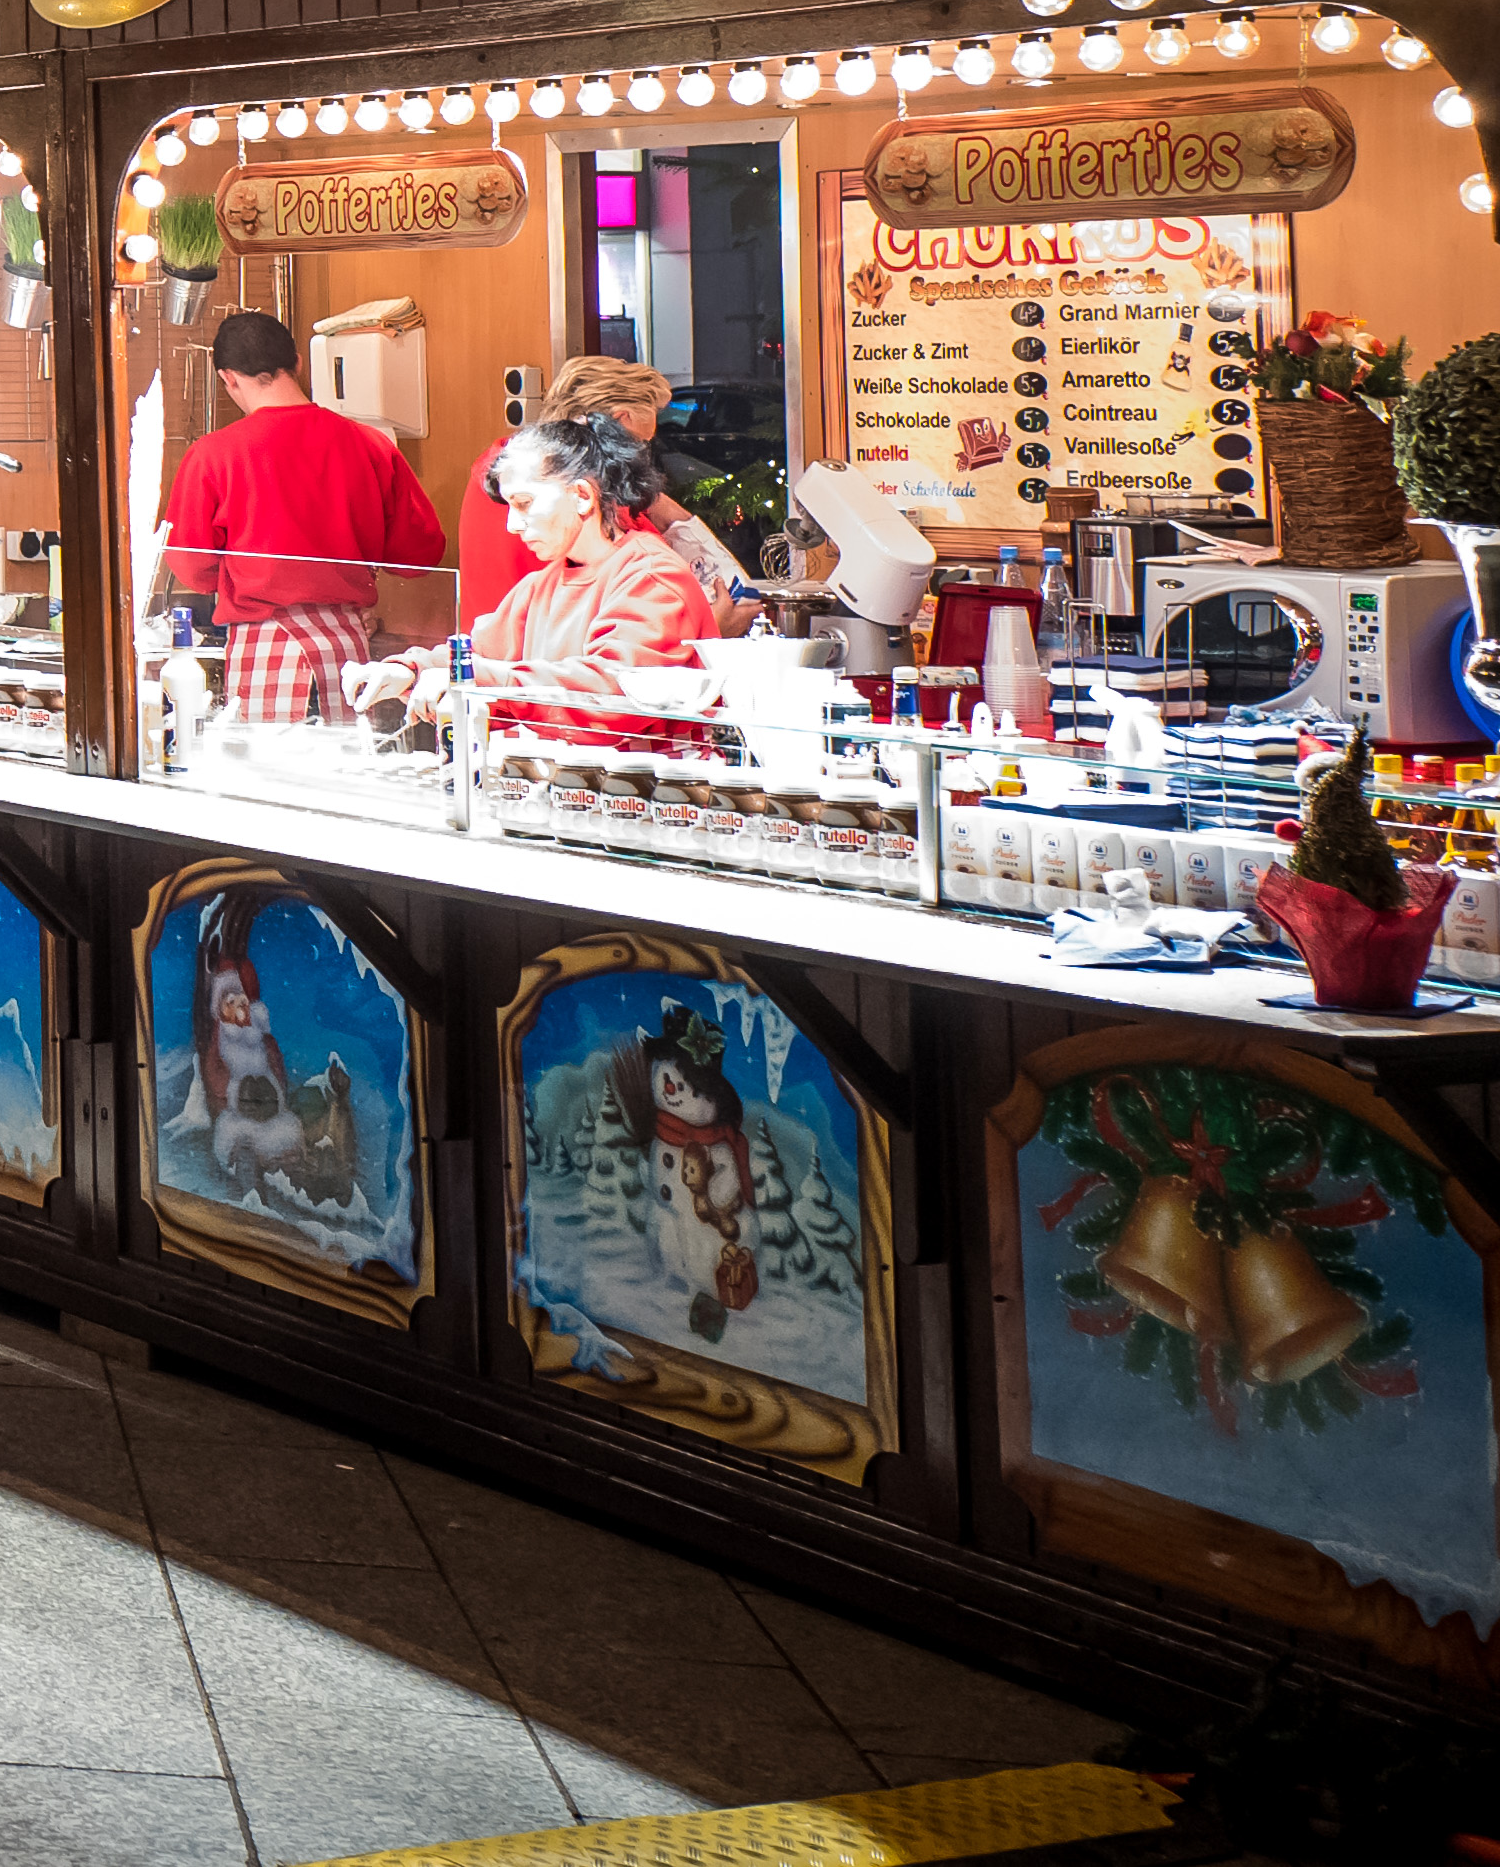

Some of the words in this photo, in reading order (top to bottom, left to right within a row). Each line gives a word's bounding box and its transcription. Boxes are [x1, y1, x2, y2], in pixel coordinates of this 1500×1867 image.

[954, 121, 1243, 205] Poffertjes
[275, 173, 459, 235] Poffertjes
[910, 273, 1053, 306] Spanisches
[1059, 268, 1168, 296] Gebäck
[851, 311, 907, 327] Zucker
[1059, 303, 1117, 322] Grand
[1125, 302, 1201, 320] Marnier
[853, 344, 908, 361] Zucker
[913, 343, 925, 360] &
[931, 343, 969, 360] Zimt
[1061, 336, 1141, 355] Eierlikör
[854, 378, 903, 394] Weiße
[908, 376, 1008, 394] Schokolade
[1062, 370, 1151, 388] Amaretto
[855, 411, 950, 428] Schokolade
[1063, 403, 1159, 421] Cointreau
[857, 445, 909, 461] nutella
[1064, 437, 1177, 455] Vanillesoße
[1066, 470, 1192, 489] Erdbeersoße
[553, 789, 596, 805] nutella
[603, 797, 646, 813] nutella
[655, 805, 699, 820] nutella
[819, 829, 868, 845] nutella
